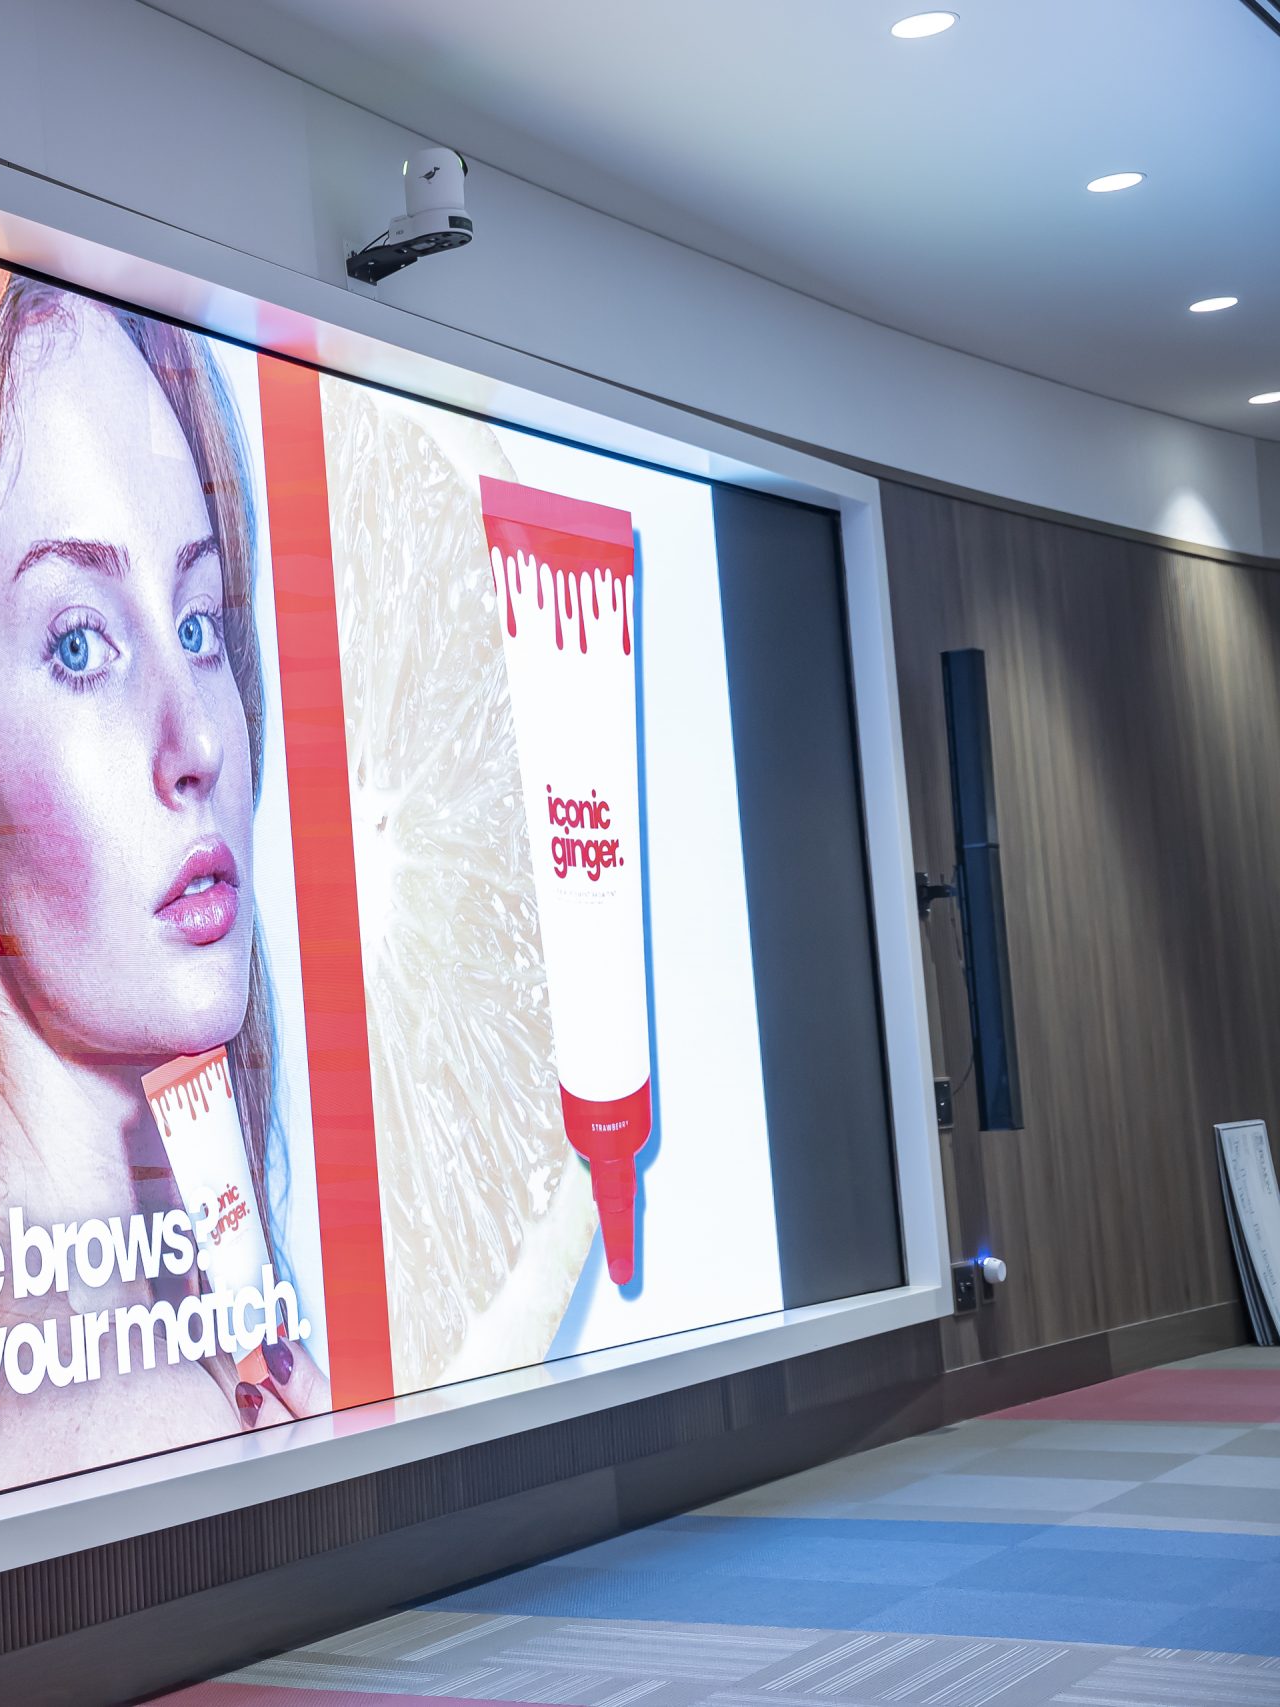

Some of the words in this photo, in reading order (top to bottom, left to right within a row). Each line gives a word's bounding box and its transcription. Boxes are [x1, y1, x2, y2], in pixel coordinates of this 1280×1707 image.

[546, 784, 611, 829] iconic
[551, 826, 624, 881] ginger.
[591, 1120, 629, 1132] STRAWBERRY
[10, 1187, 219, 1299] brows?
[115, 1264, 312, 1374] match.
